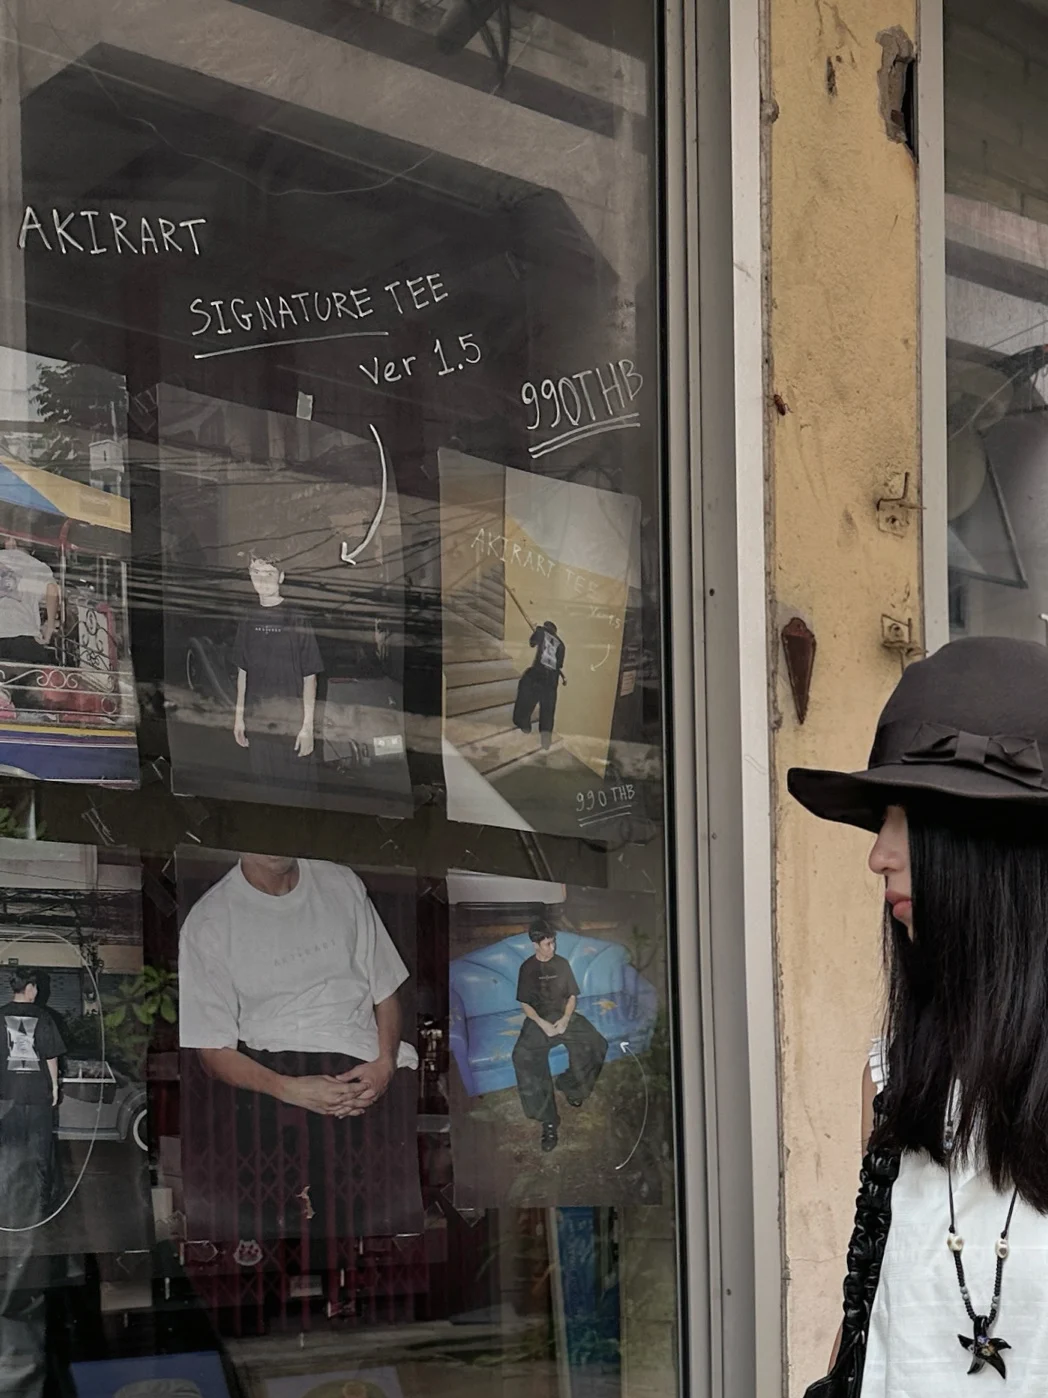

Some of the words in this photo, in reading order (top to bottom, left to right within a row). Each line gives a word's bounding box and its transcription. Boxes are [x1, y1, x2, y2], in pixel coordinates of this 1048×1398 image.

[18, 206, 207, 255] AKIRART
[189, 287, 374, 337] SIGNATURE
[384, 272, 449, 315] TEE
[359, 356, 417, 385] Ver
[434, 333, 482, 376] 1.5
[575, 789, 608, 812] 990
[610, 783, 636, 803] THB
